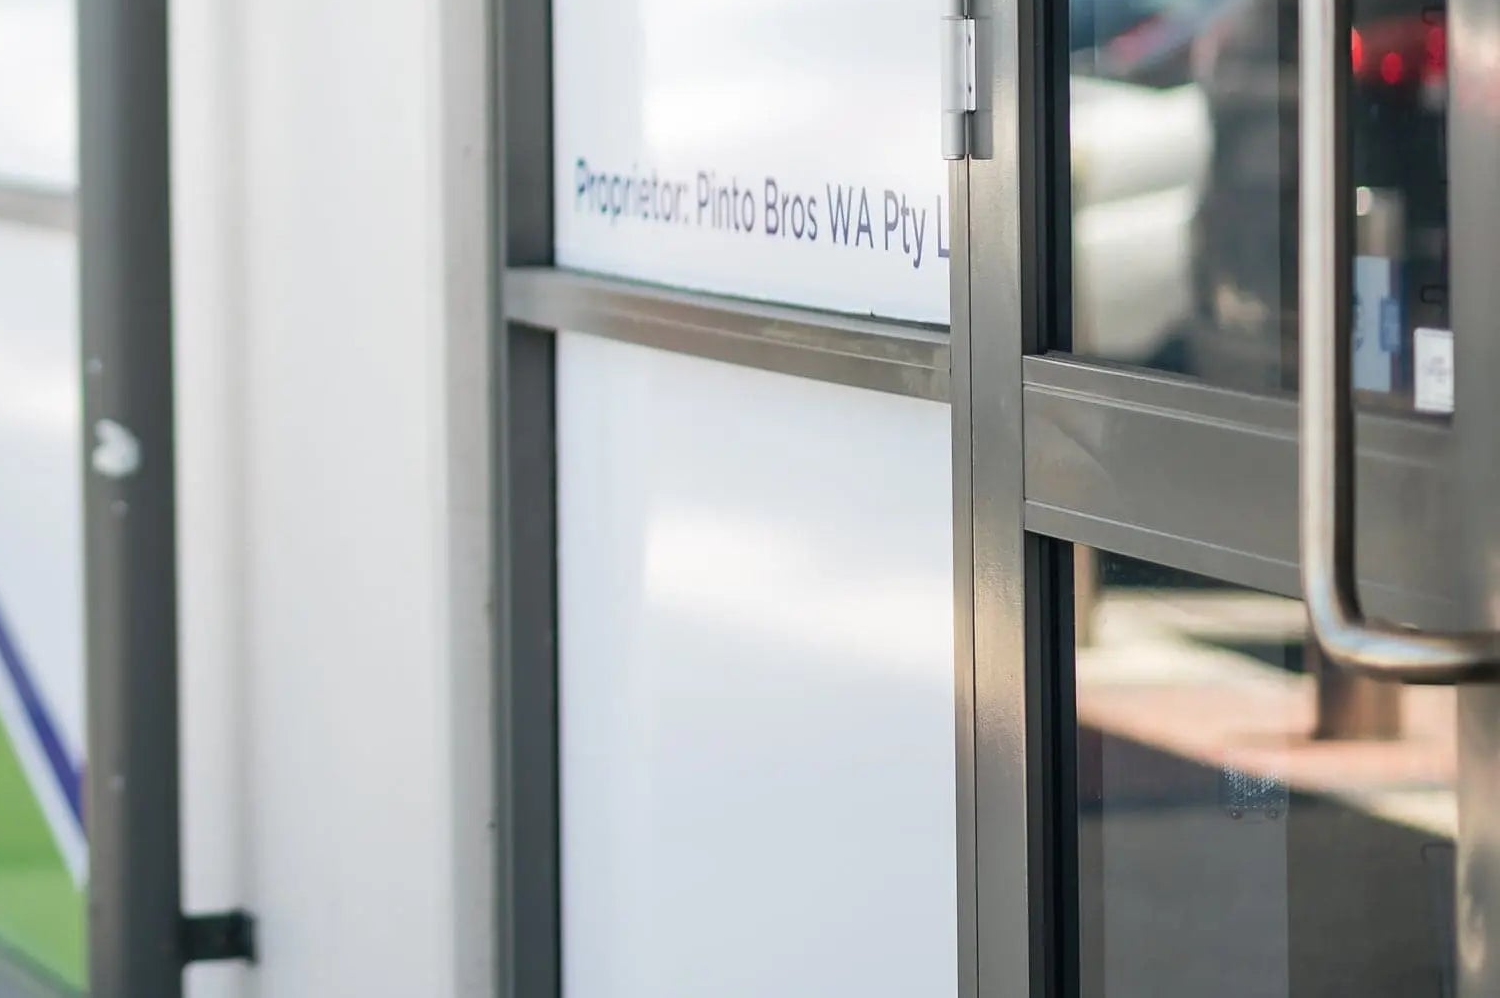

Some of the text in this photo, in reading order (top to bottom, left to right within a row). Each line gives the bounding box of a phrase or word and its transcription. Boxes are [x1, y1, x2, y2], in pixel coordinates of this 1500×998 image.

[575, 157, 689, 227] Proprietor:
[697, 170, 756, 234] Pinto
[764, 177, 819, 242] Bros
[826, 182, 875, 250] WA
[884, 189, 927, 269] Pty
